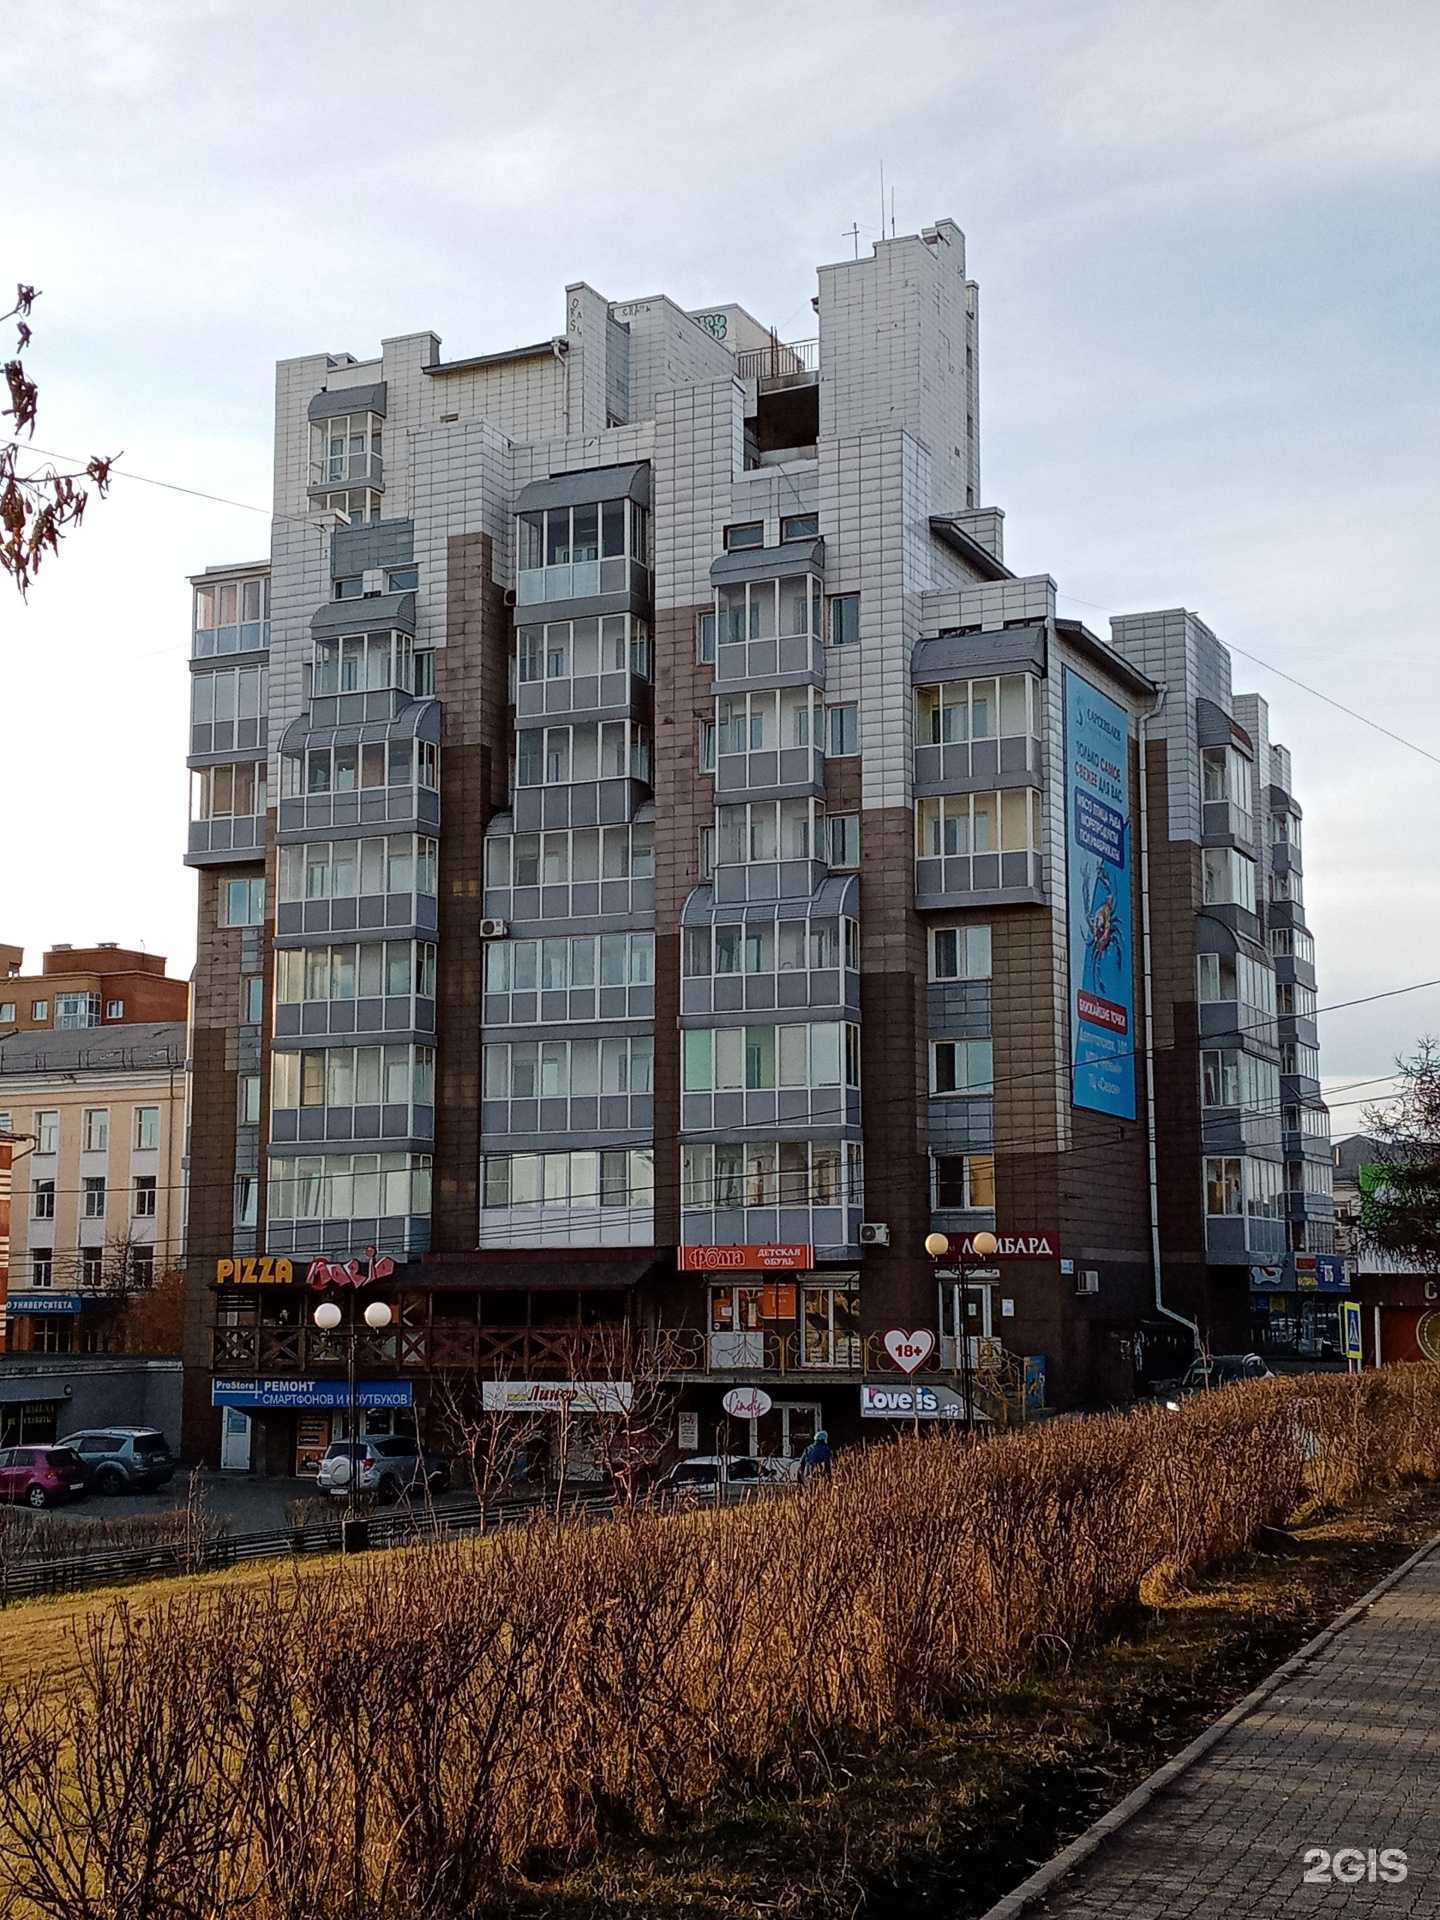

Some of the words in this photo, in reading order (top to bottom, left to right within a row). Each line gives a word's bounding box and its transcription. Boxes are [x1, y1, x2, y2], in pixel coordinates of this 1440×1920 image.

[757, 1248, 801, 1257] ДЕТСКАЯ
[962, 1237, 1053, 1255] ЛМБАРД
[217, 1257, 294, 1284] PIZZA
[895, 1344, 923, 1358] 18+
[215, 1380, 255, 1390] ProStore
[263, 1381, 316, 1392] РЕМОНТ
[262, 1393, 334, 1405] СМАРТФОНОВ
[336, 1394, 345, 1405] И
[863, 1387, 913, 1409] Love
[916, 1387, 938, 1410] is
